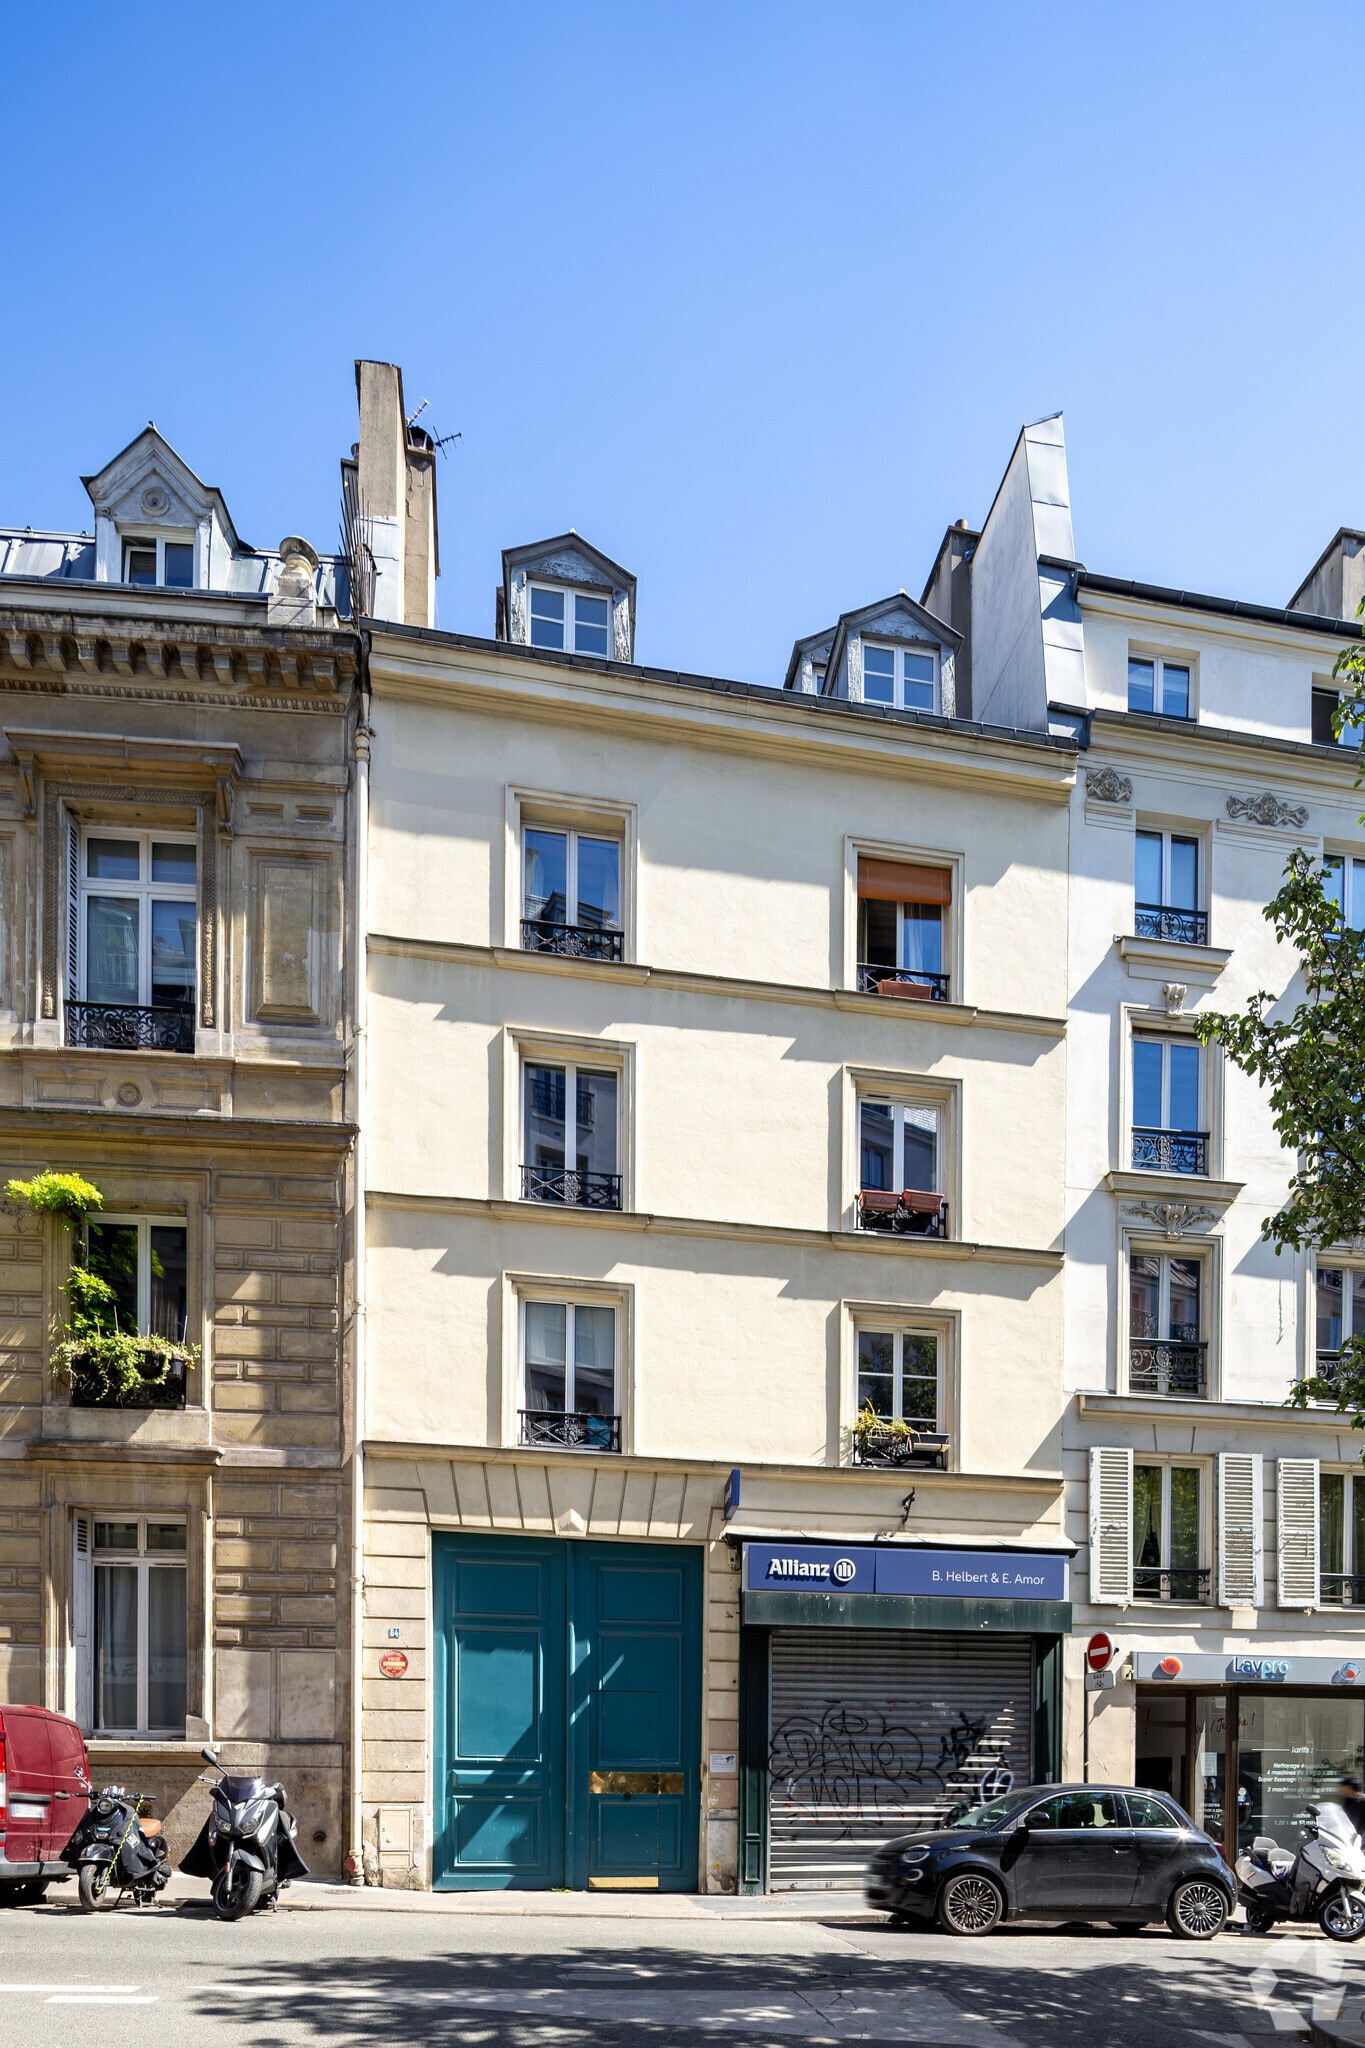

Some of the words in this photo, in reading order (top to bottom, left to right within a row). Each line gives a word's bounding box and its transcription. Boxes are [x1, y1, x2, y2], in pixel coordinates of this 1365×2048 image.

[768, 1558, 830, 1577] Allianz
[932, 1570, 943, 1582] B.
[946, 1571, 989, 1584] Helbert
[991, 1573, 1000, 1584] &
[1002, 1573, 1012, 1585] E.
[1014, 1574, 1046, 1585] Amor
[1233, 1656, 1292, 1679] Lavpro
